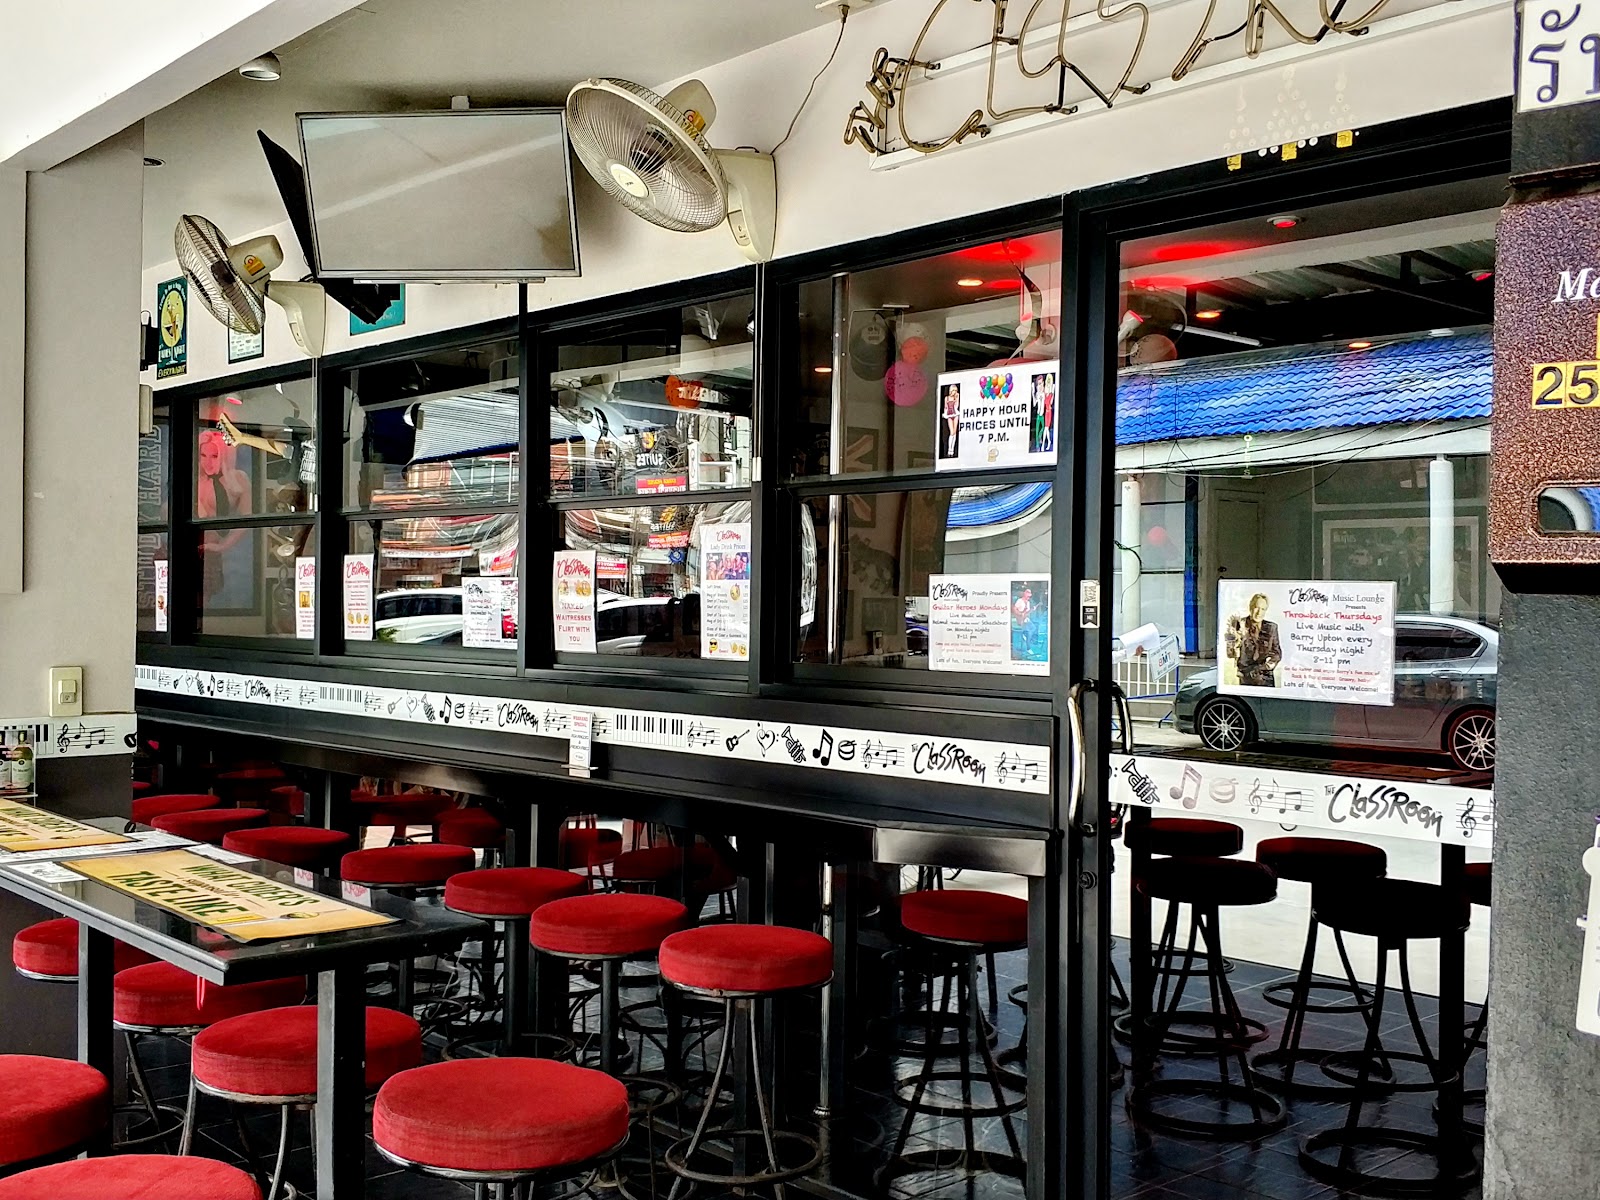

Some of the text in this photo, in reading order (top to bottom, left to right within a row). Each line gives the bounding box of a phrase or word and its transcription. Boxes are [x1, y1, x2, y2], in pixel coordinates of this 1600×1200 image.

[963, 404, 1027, 418] HAPPY HOUR
[960, 418, 1030, 431] PRICES UNTIL
[979, 433, 1009, 443] 7 P.M.
[1332, 593, 1354, 602] Music
[1356, 594, 1385, 604] Lounge
[1283, 610, 1382, 624] Throwback Thursdays
[1296, 622, 1365, 631] Live Music with
[1290, 632, 1373, 646] Barry Upton every
[1296, 644, 1364, 658] Thursday night
[1337, 658, 1350, 668] pm
[1321, 683, 1347, 691] Everyone
[180, 864, 320, 907] WHAT CIDER'S
[107, 870, 249, 916] TASTE LIKE
